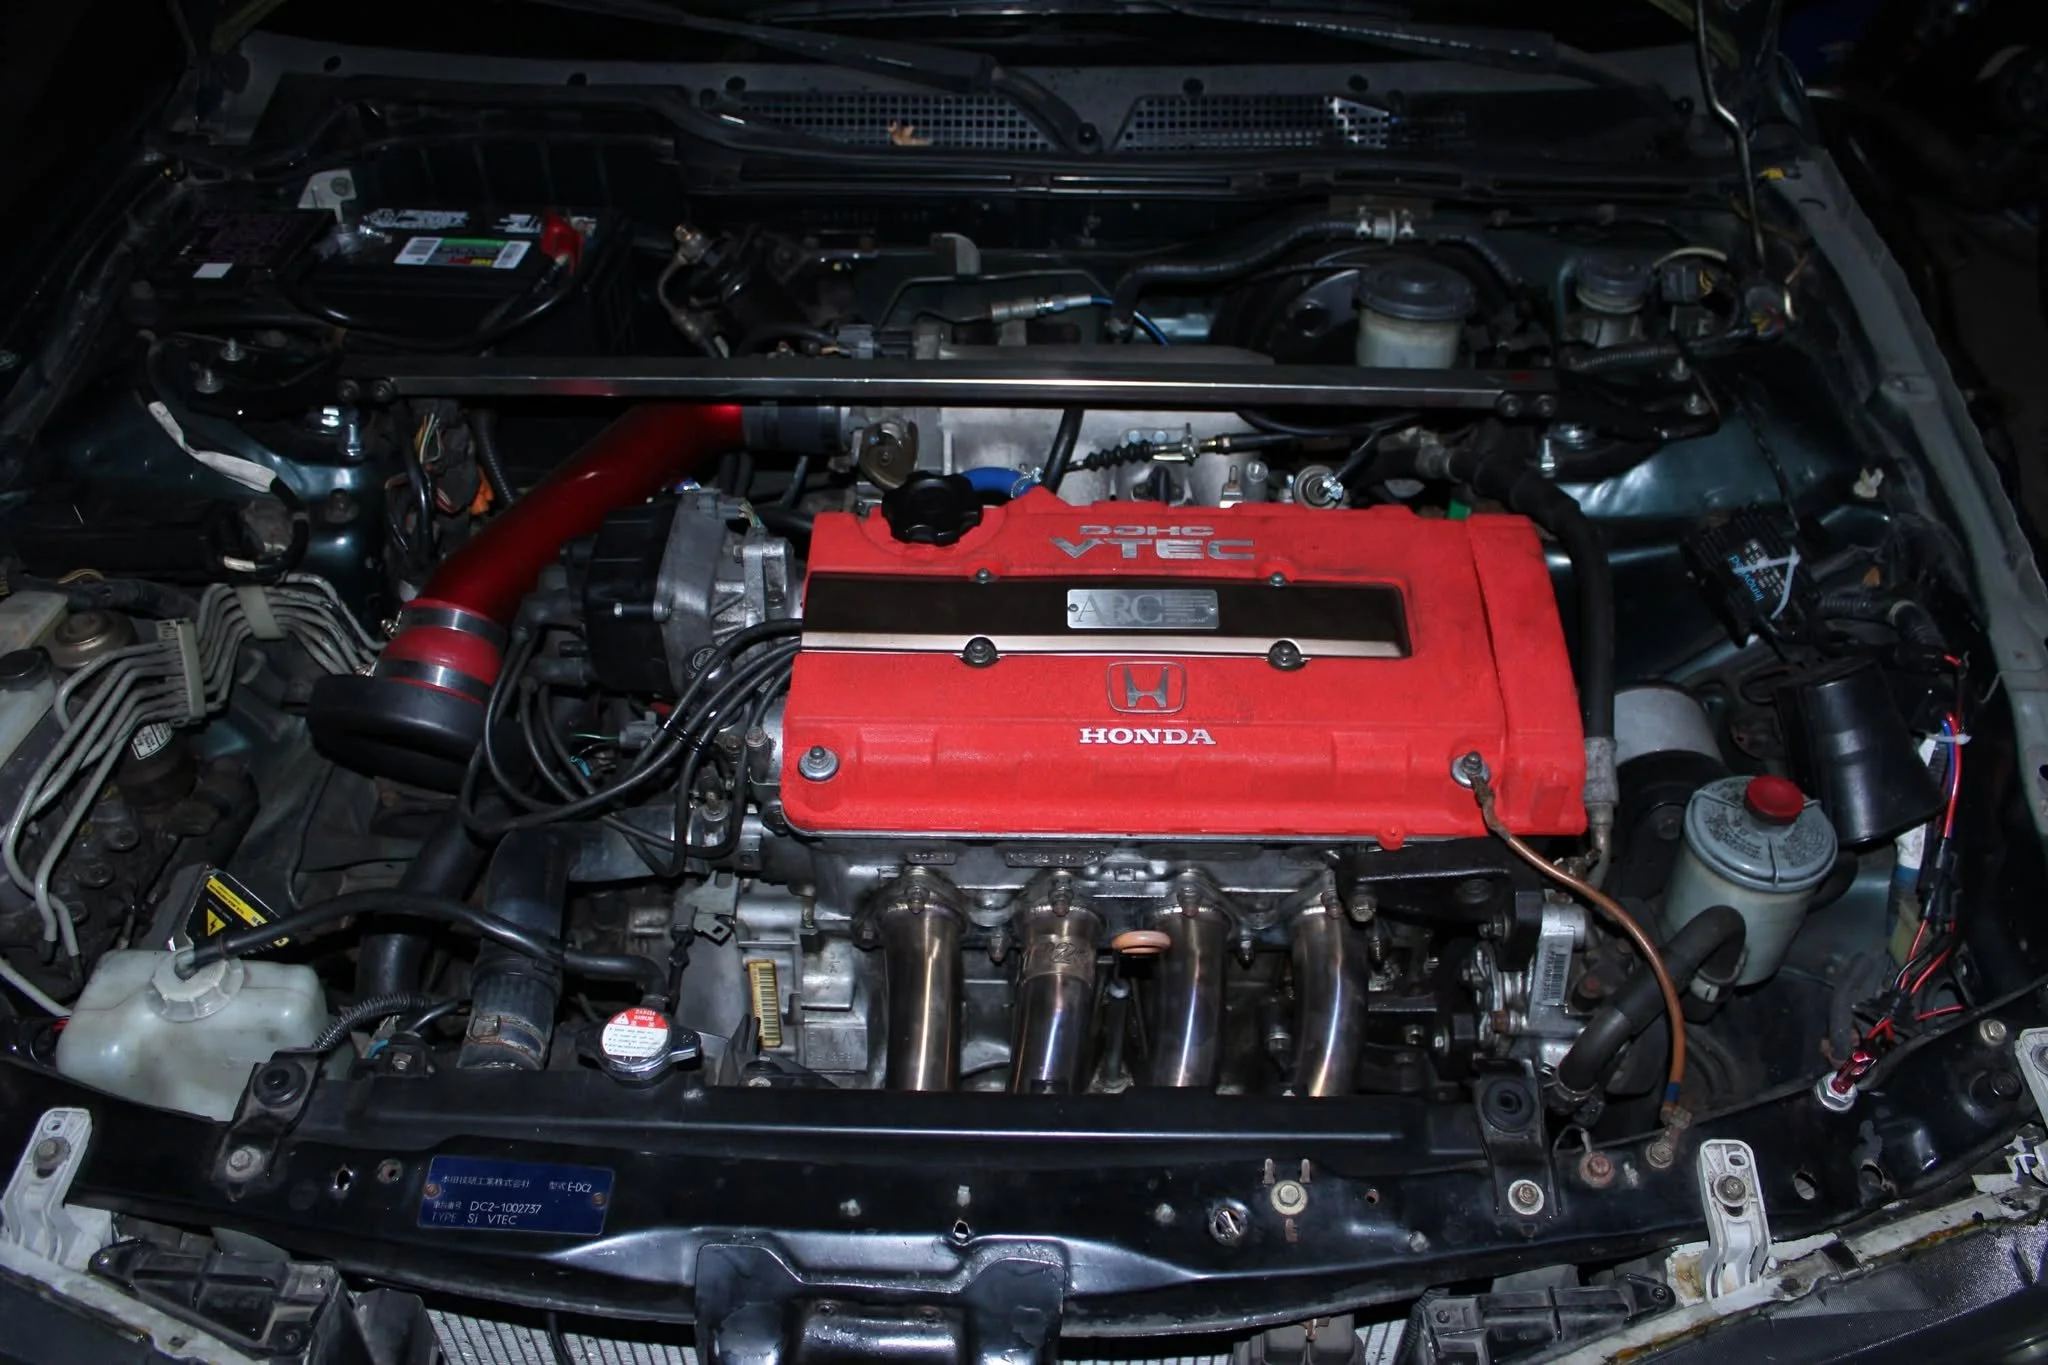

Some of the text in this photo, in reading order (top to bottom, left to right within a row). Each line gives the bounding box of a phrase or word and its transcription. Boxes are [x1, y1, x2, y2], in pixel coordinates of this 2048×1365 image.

[1079, 524, 1214, 537] DOHC
[1049, 537, 1255, 560] VTEC
[1075, 593, 1163, 624] ARC
[1079, 727, 1216, 745] HONDA
[567, 1181, 593, 1193] E-DC2
[469, 1201, 542, 1215] DC2-1002737
[487, 1214, 518, 1225] VTEC
